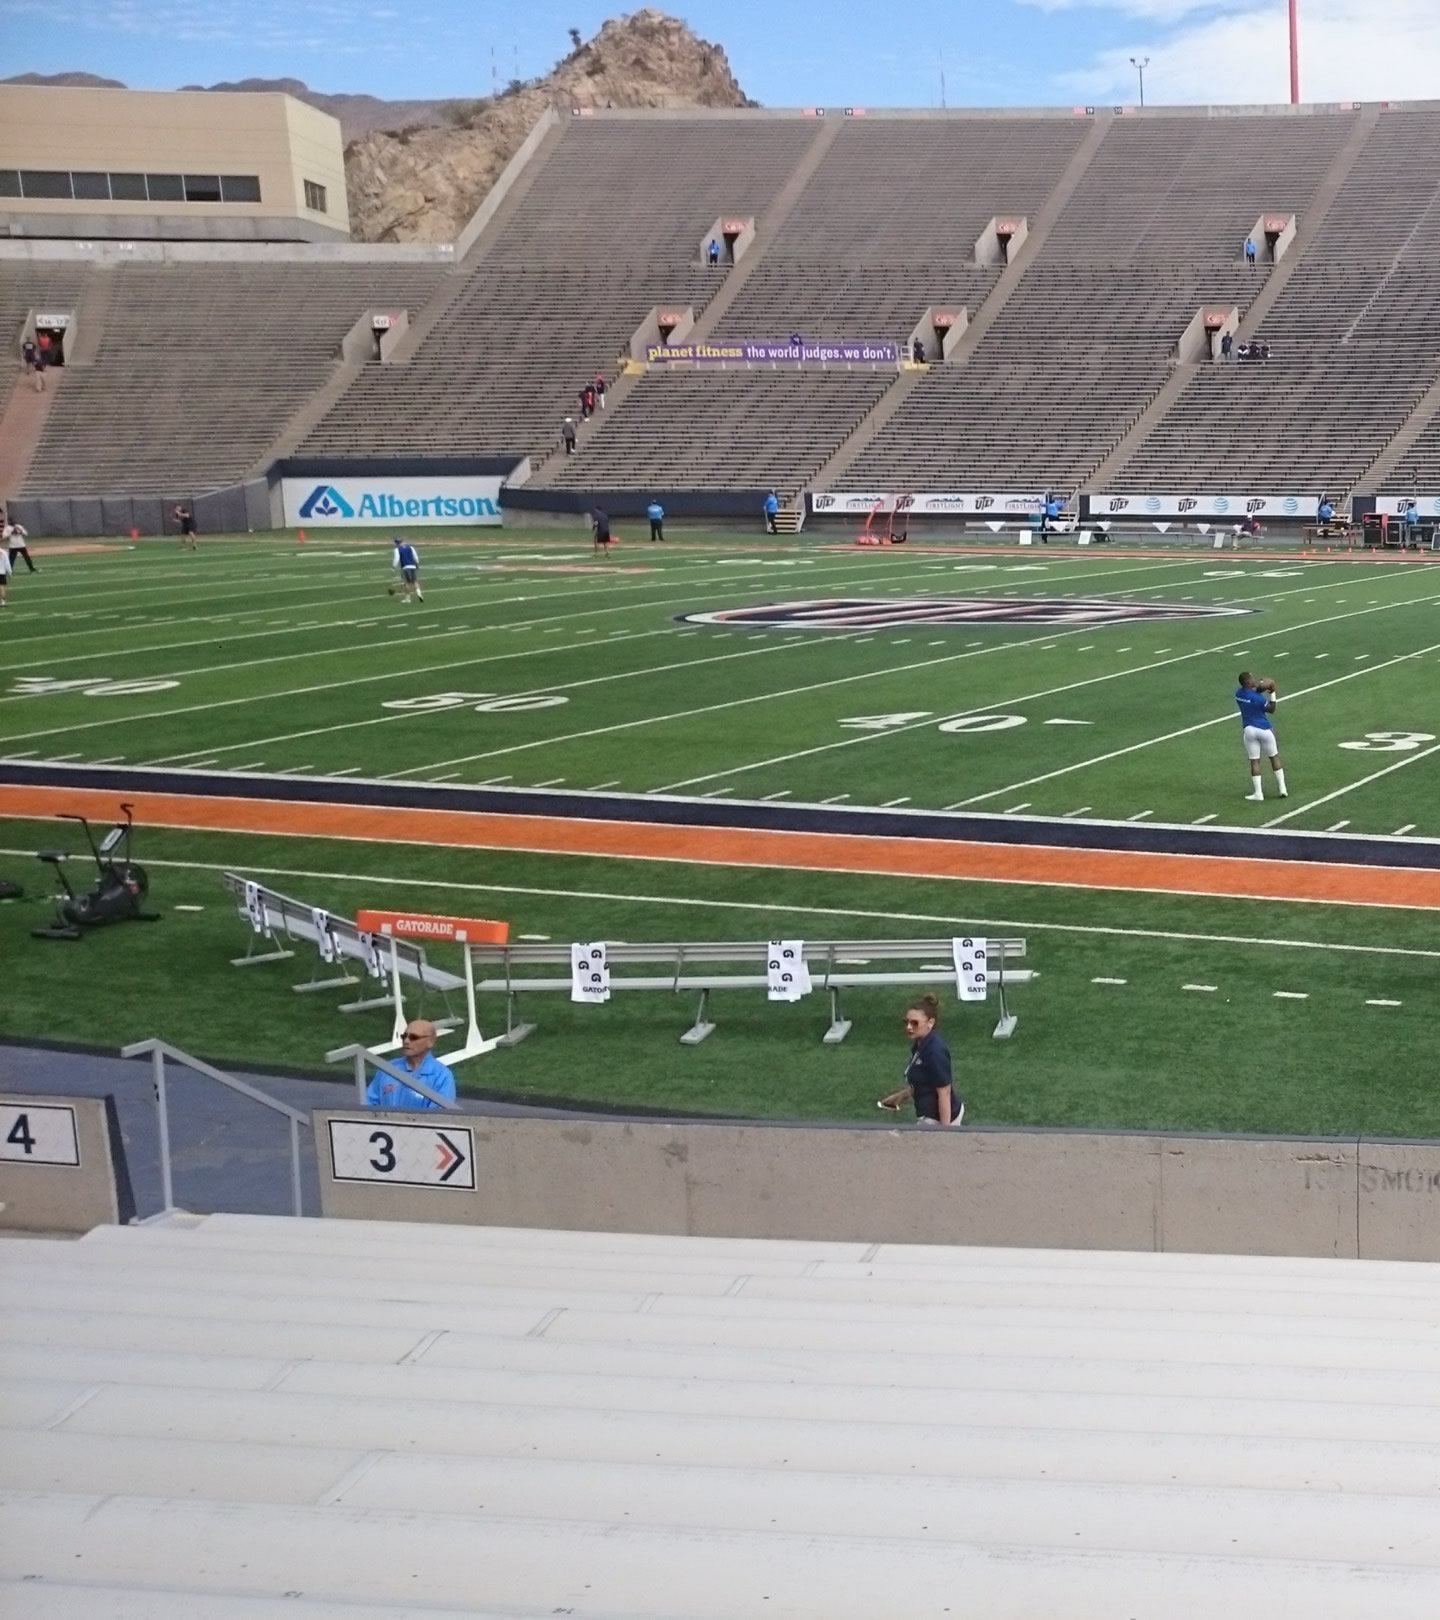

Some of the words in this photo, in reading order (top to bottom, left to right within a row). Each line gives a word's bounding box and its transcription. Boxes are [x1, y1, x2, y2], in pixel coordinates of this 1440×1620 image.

[648, 346, 693, 360] planet
[696, 346, 743, 357] fitness
[747, 347, 766, 358] the
[768, 347, 799, 358] world
[802, 347, 842, 361] judges.
[844, 350, 861, 358] we
[863, 347, 895, 358] don't.
[395, 919, 454, 936] GATORADE
[962, 938, 973, 948] G
[591, 949, 602, 959] G
[783, 949, 794, 958] G
[974, 950, 986, 959] G
[578, 960, 590, 970] G
[769, 960, 780, 969] G
[962, 961, 973, 971] G
[591, 973, 602, 983] G
[781, 973, 793, 982] G
[974, 973, 986, 983] G
[7, 1113, 36, 1154] 4
[368, 1131, 396, 1173] 3
